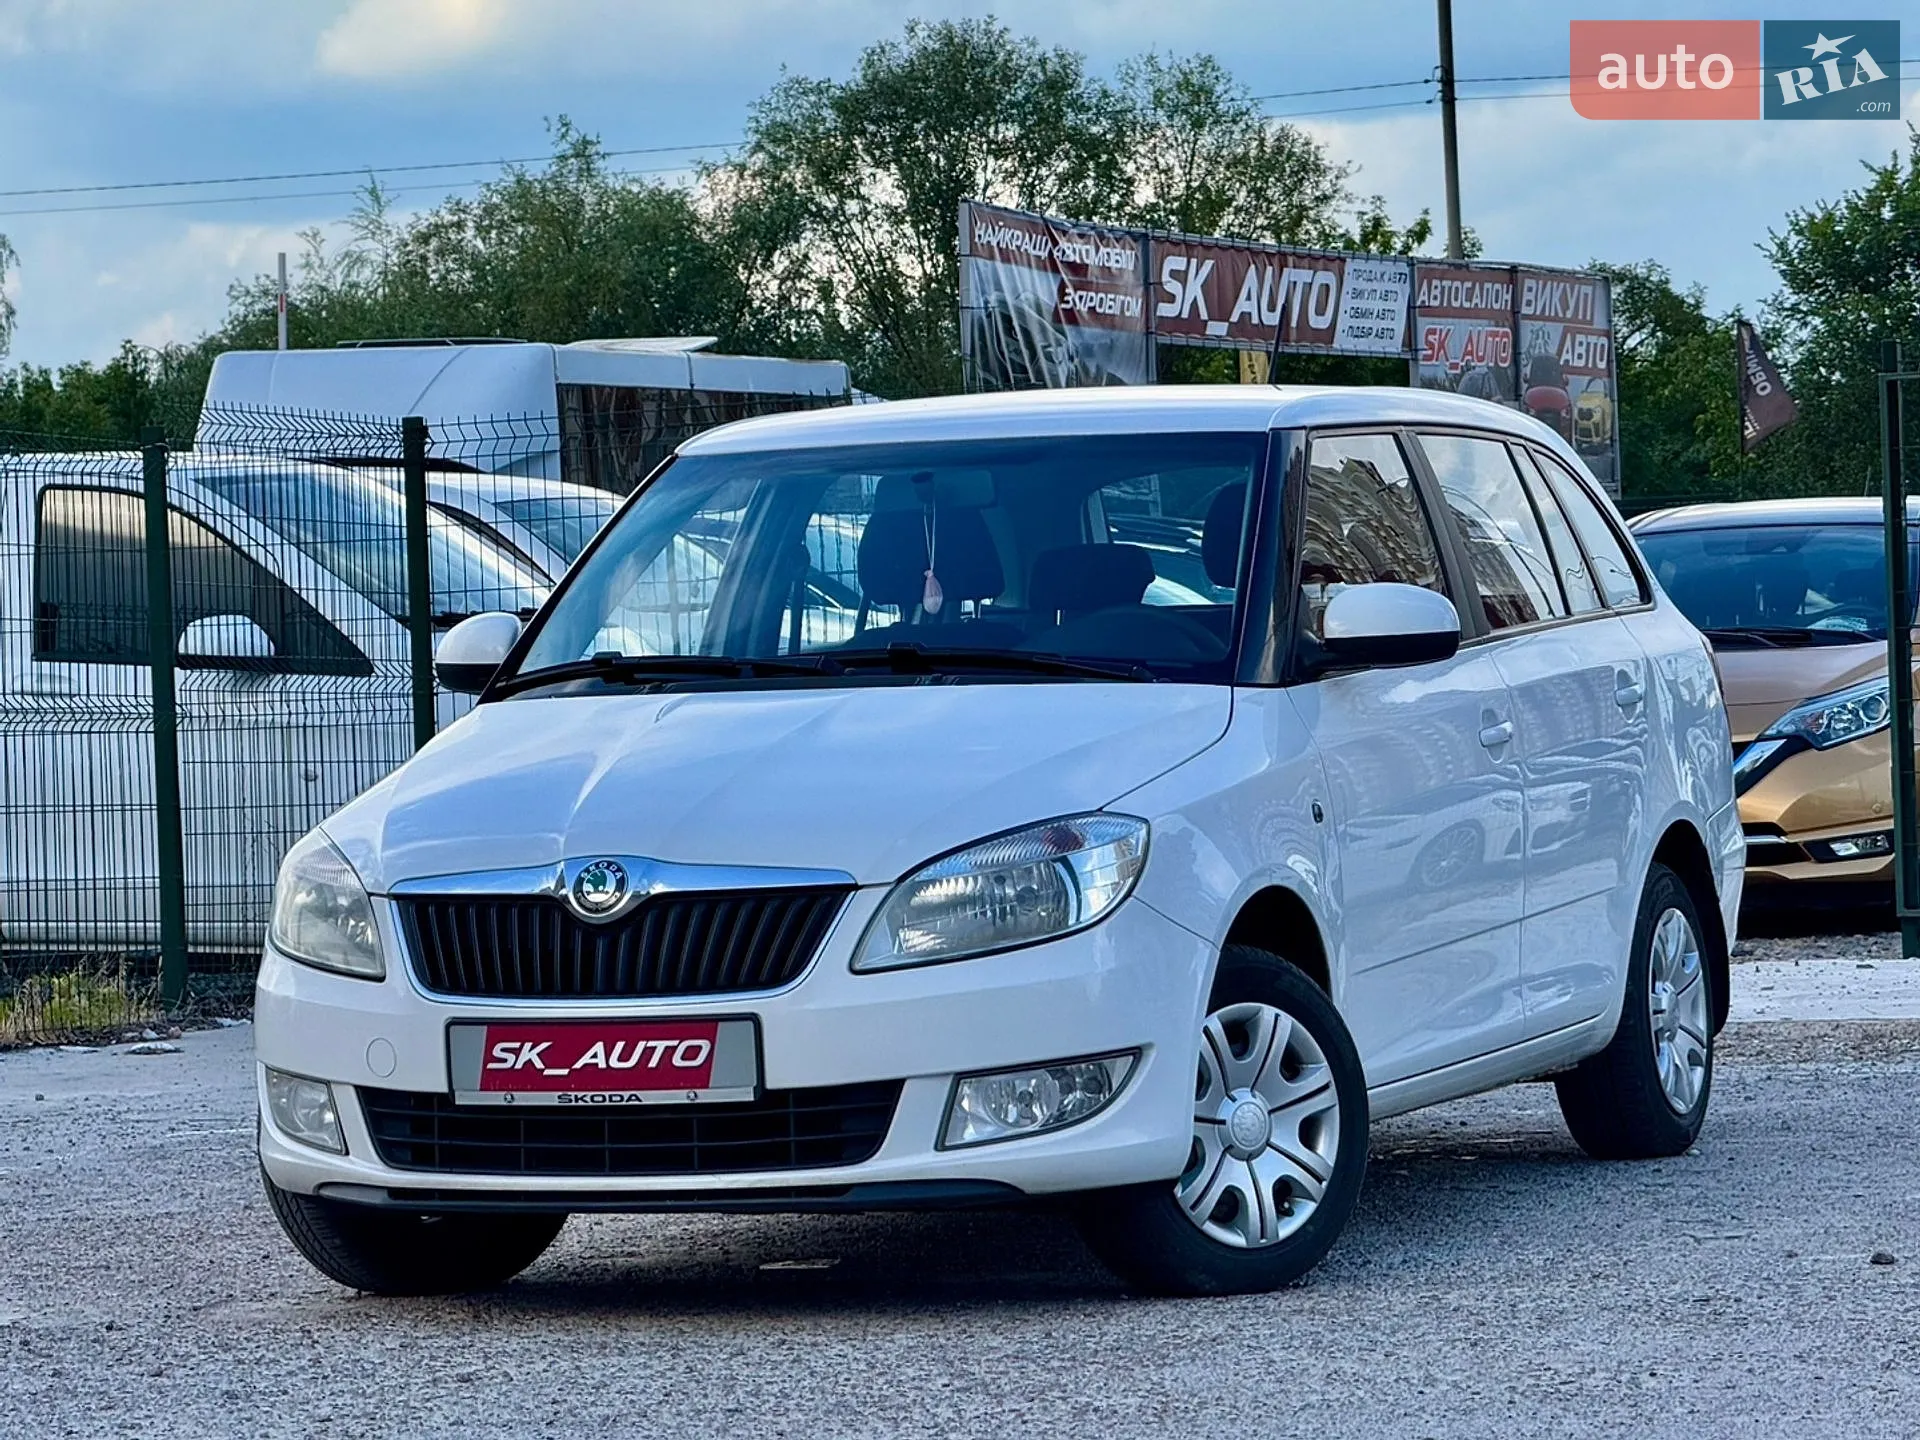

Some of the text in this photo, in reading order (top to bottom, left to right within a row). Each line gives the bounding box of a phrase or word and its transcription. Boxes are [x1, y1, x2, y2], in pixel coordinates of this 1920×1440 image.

[1156, 255, 1337, 337] SK_AUTO
[1416, 278, 1513, 311] АВТОСАЛОН
[1520, 278, 1594, 321] ВИКУП
[1374, 327, 1395, 340] АВТО
[1375, 308, 1396, 321] АВТО
[1419, 325, 1513, 374] SK_AUTO
[1559, 331, 1609, 369] АВТО
[486, 1038, 712, 1077] SK_AUTO
